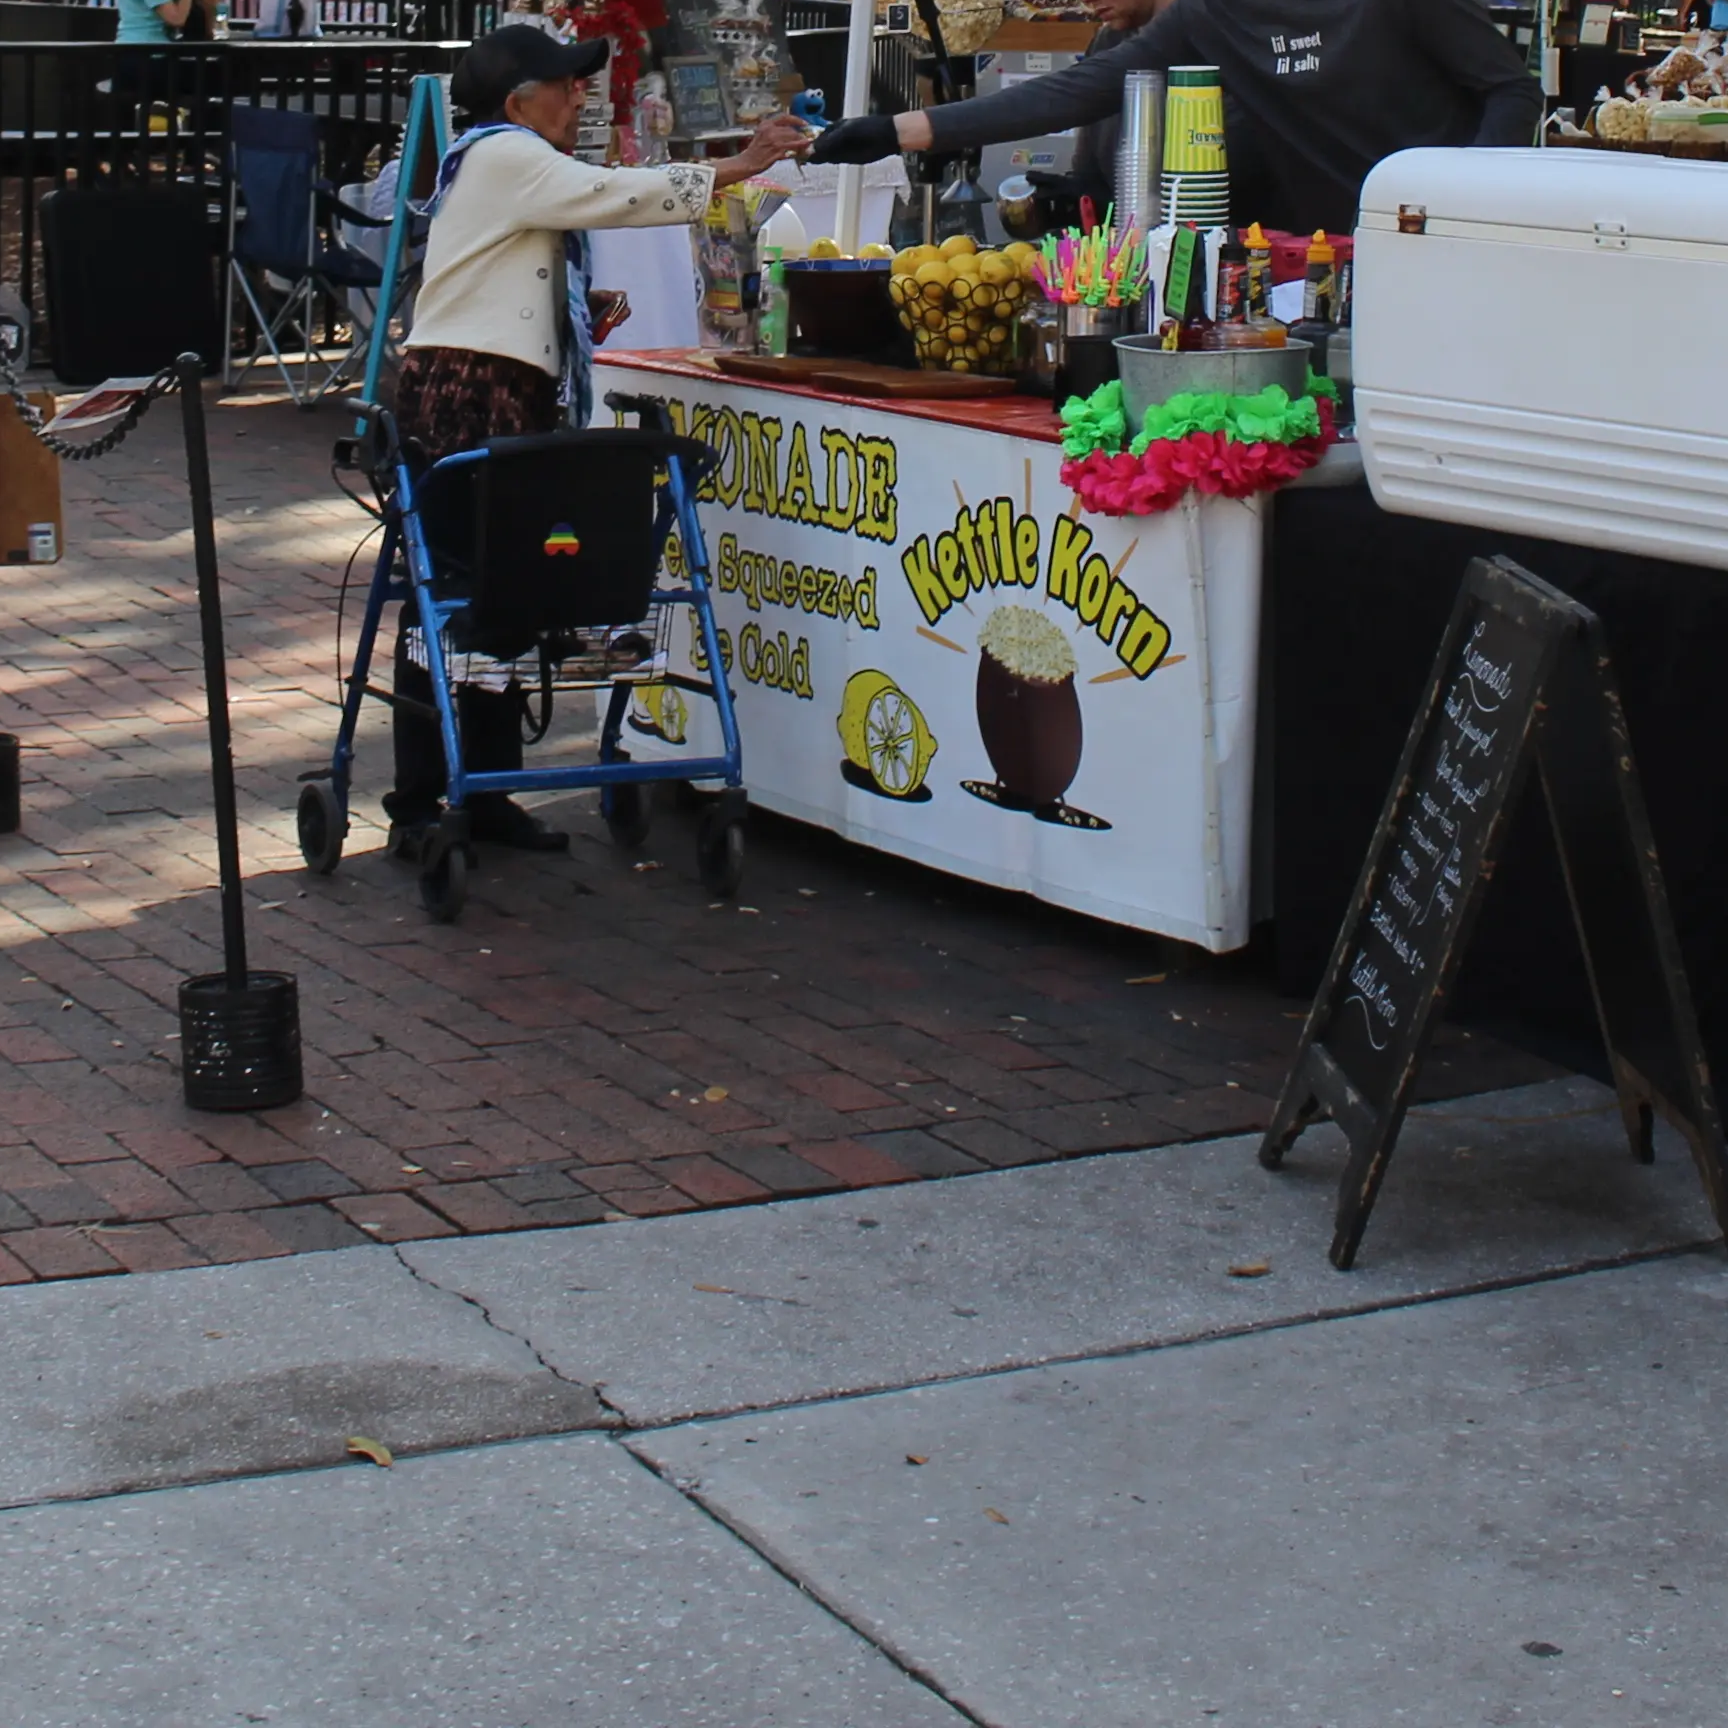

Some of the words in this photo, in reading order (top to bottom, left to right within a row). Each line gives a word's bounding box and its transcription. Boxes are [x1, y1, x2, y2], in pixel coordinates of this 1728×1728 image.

[1270, 34, 1286, 54] lil
[1290, 31, 1322, 51] sweet
[1276, 56, 1291, 75] lil
[1293, 53, 1321, 73] salty
[718, 531, 880, 631] Squeezed
[902, 496, 1040, 627] Kettle
[1047, 514, 1172, 681] Korn
[738, 621, 814, 701] Cold
[1463, 620, 1513, 700] Lemonade
[1349, 948, 1378, 1000] Kettle
[1375, 981, 1399, 1028] Korn
